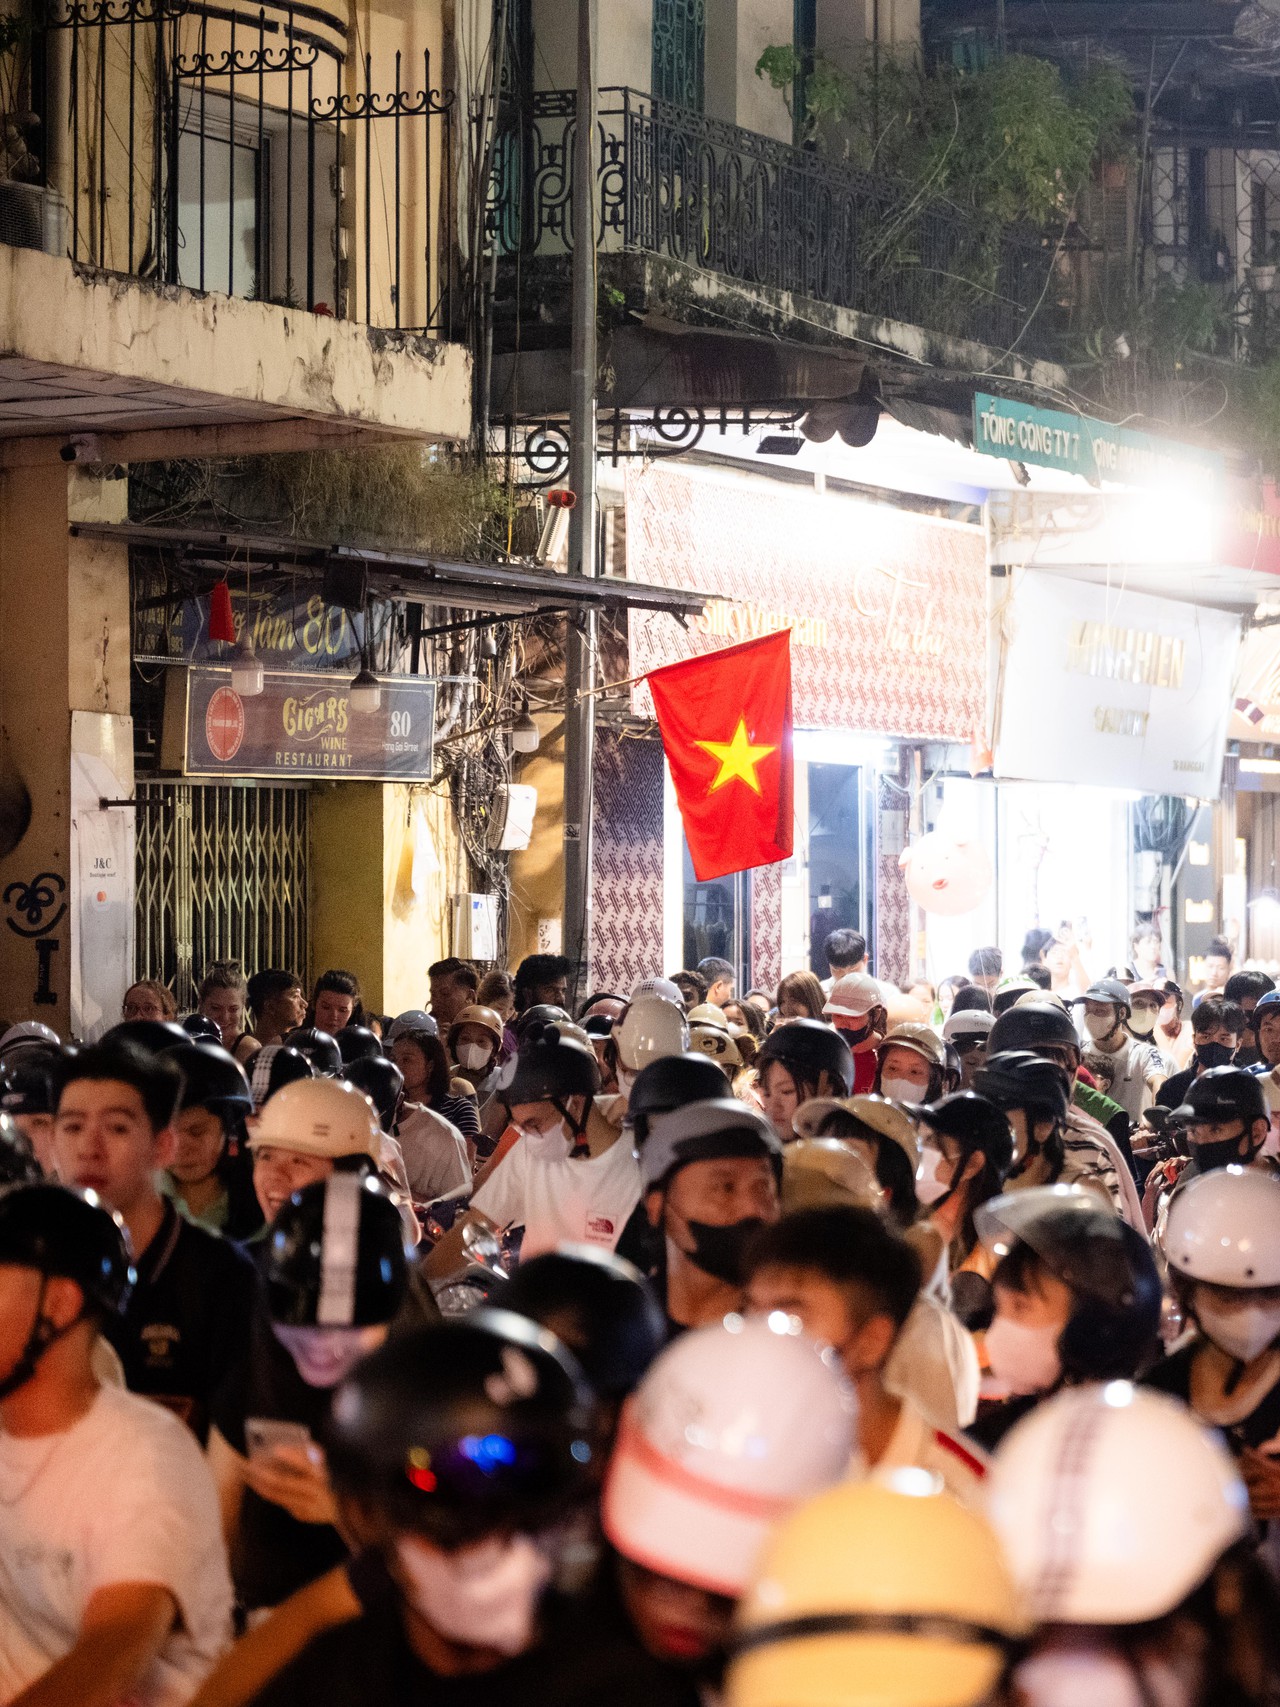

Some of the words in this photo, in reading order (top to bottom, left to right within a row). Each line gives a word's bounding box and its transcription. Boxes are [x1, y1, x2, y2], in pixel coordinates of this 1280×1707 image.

[981, 399, 1015, 446] TỔNG
[1018, 416, 1052, 455] CÔNG
[1054, 429, 1070, 459] TY
[302, 594, 346, 655] 80
[701, 599, 748, 640] Silky
[749, 601, 828, 648] Vietnam
[390, 710, 412, 737] 80
[320, 736, 348, 750] WINE
[275, 752, 353, 767] RESTAURANT
[93, 857, 112, 869] J&C
